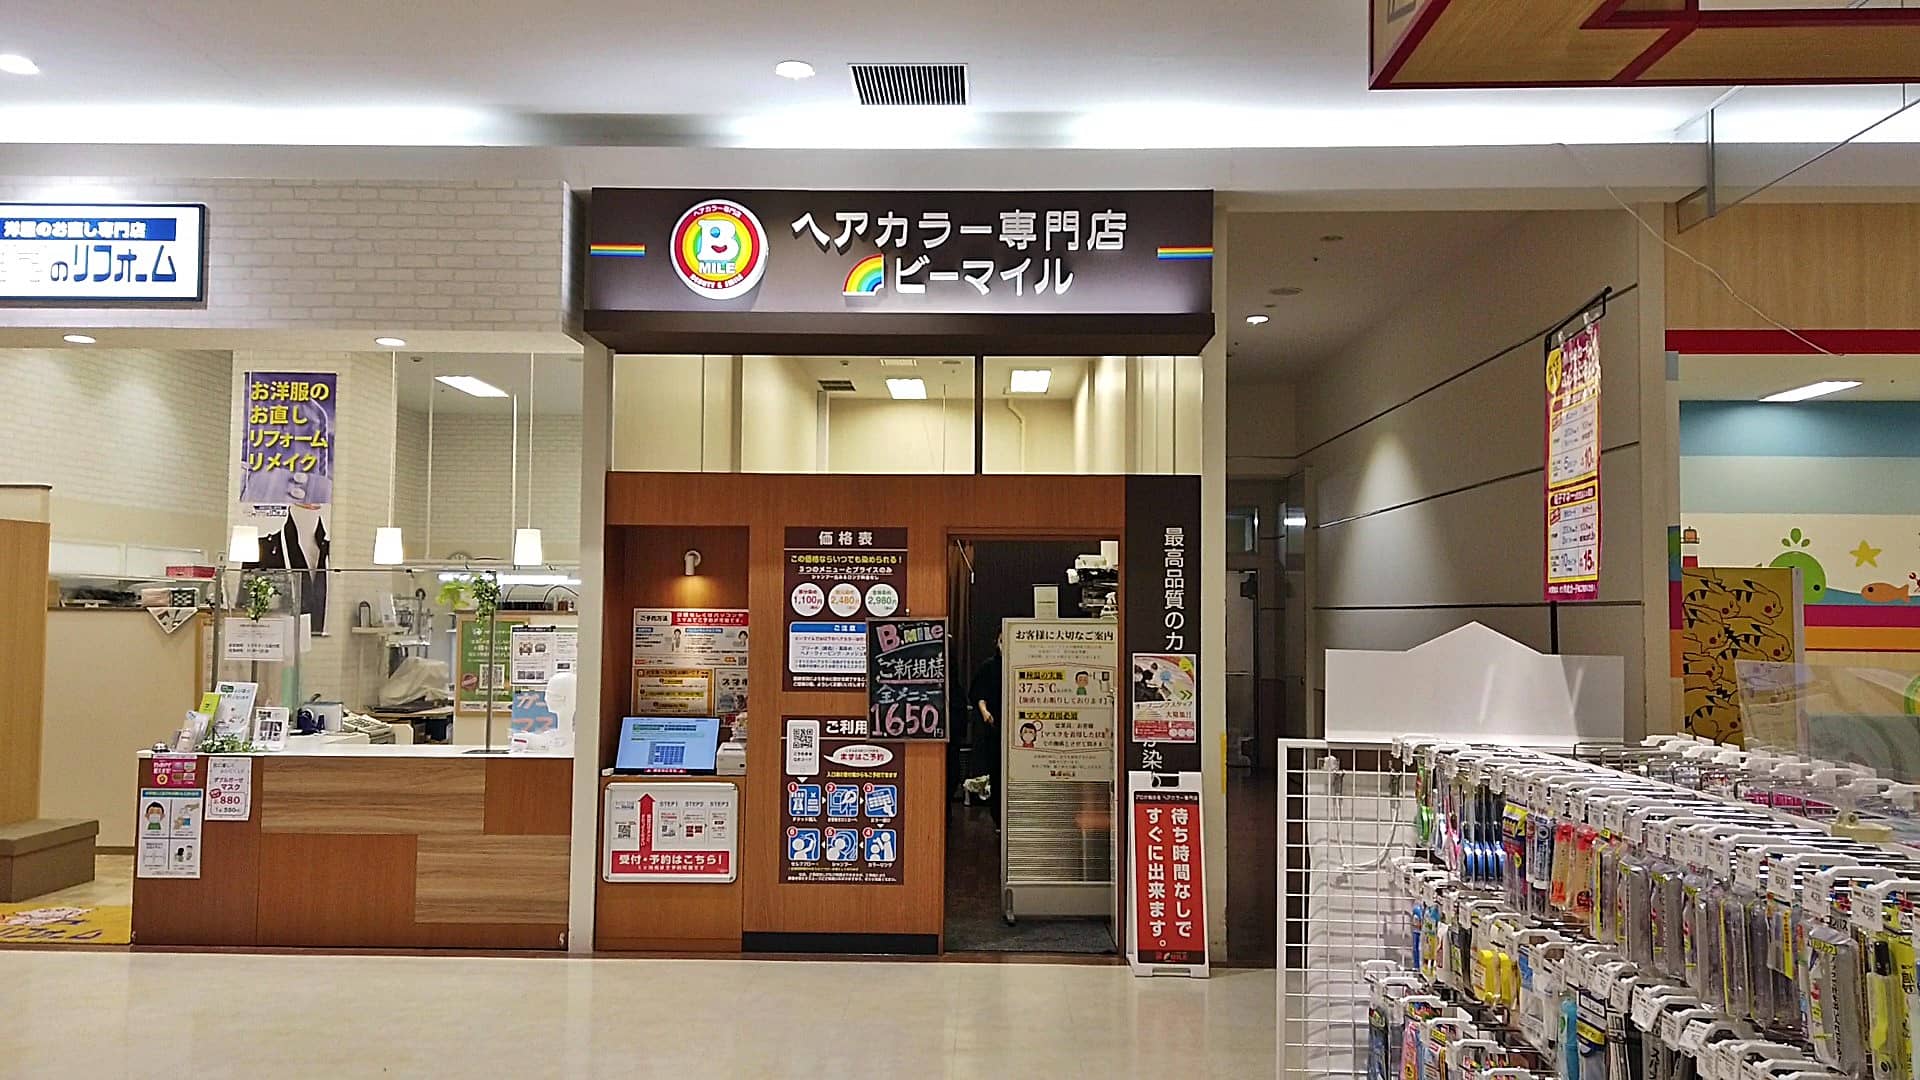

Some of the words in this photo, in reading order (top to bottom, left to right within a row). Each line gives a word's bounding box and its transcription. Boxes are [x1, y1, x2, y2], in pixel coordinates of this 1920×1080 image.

[790, 209, 1127, 251] ヘアカラー専門店
[696, 220, 740, 261] B
[699, 262, 736, 274] MILE
[895, 254, 1074, 297] ビーマイル
[251, 381, 329, 401] お洋服の
[250, 405, 308, 424] お直し
[249, 428, 328, 448] リフォーム
[249, 453, 317, 472] リメイク
[819, 531, 873, 546] 価格表
[1163, 527, 1185, 651] 最高品質の力
[876, 652, 944, 681] ご新規様
[877, 684, 943, 704] 全メニュー
[220, 796, 241, 804] 880
[618, 854, 723, 866] 受付・予約はこちら！
[1146, 807, 1168, 948] すぐに出来ます。
[1171, 807, 1192, 938] 待ち時間なしで
